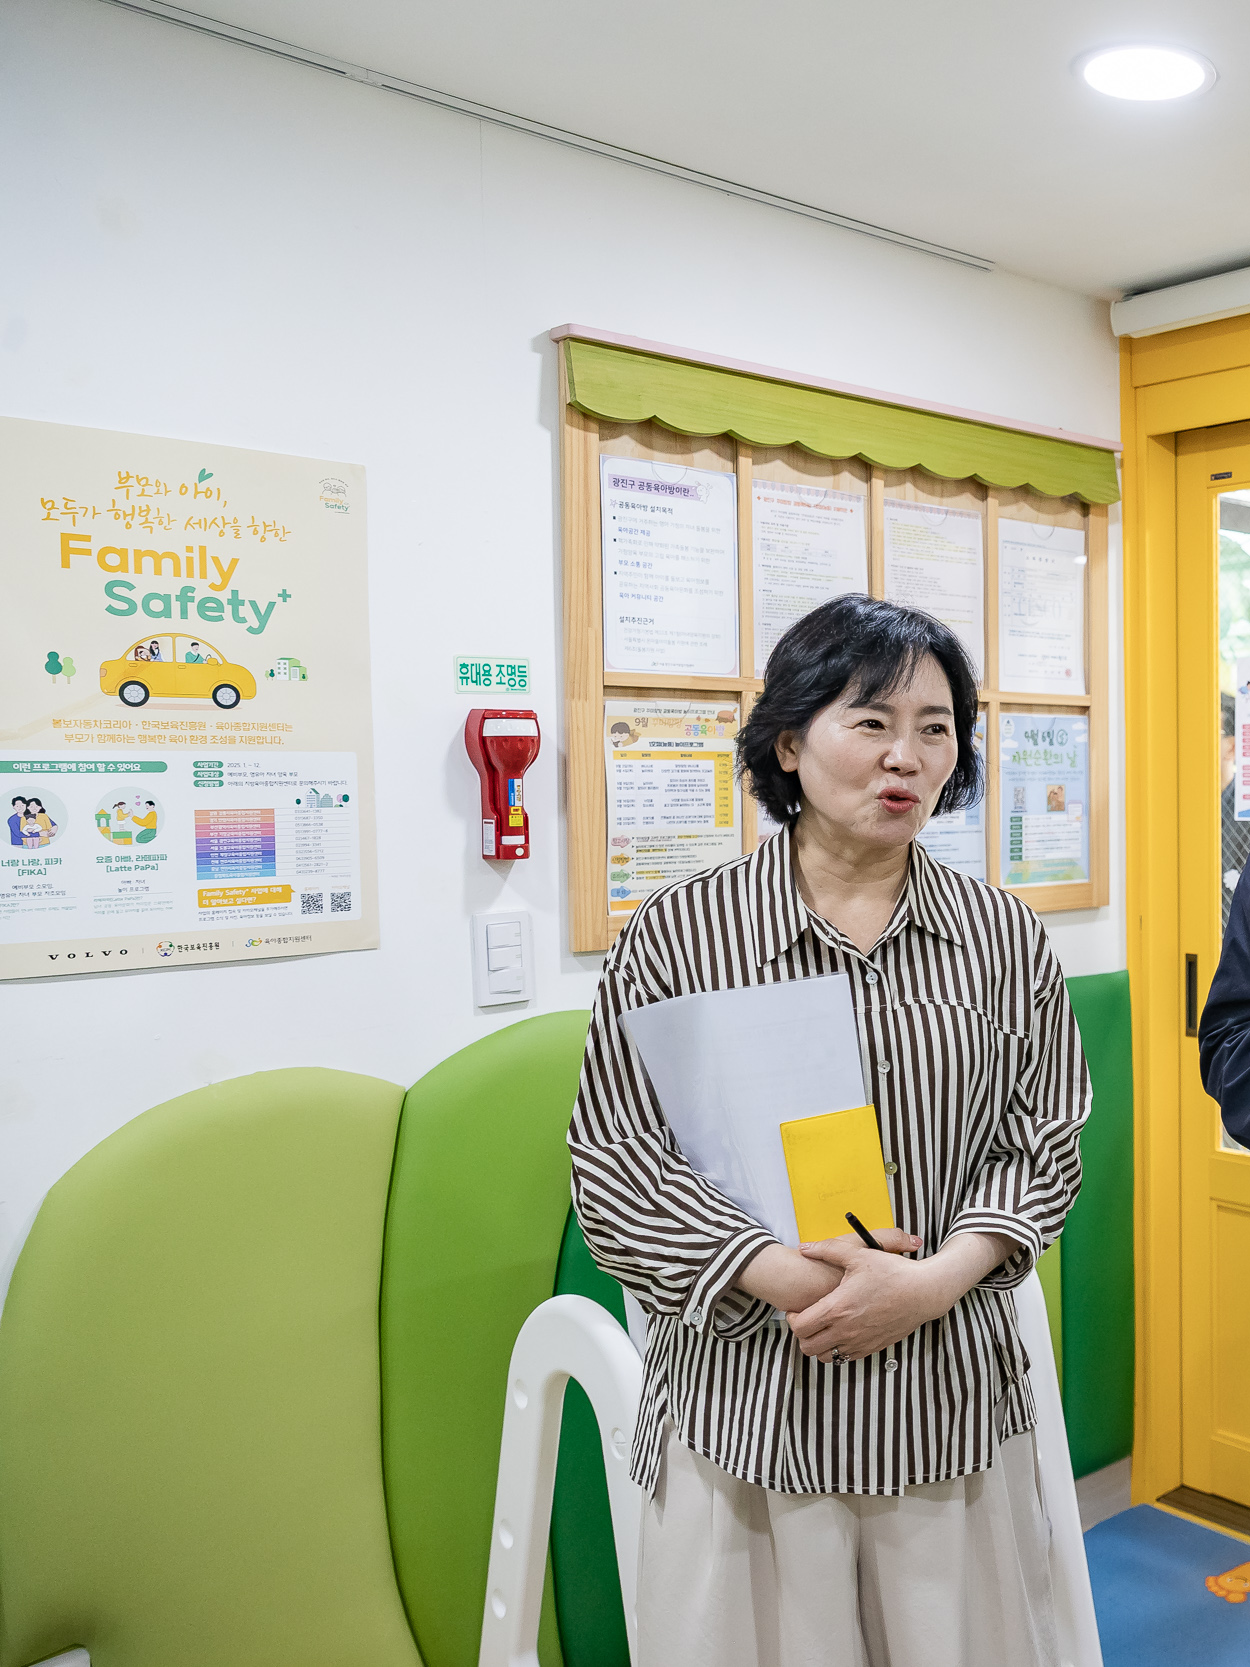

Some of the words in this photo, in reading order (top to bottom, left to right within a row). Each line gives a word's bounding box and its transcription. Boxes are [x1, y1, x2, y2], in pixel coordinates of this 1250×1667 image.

[114, 471, 171, 500] 부모와
[179, 482, 227, 507] 아이,
[613, 478, 636, 489] 광진구
[320, 496, 344, 504] Family
[619, 500, 648, 512] 공동육아방
[650, 506, 673, 514] 설치목적
[40, 497, 101, 526] 모두가
[106, 499, 177, 534] 행복한
[184, 516, 241, 539] 세상을
[247, 516, 291, 542] 향한
[618, 526, 638, 535] 육아공간
[60, 532, 240, 591] Family
[619, 616, 654, 624] 설치추진근거
[459, 663, 492, 686] 휴대용
[496, 664, 527, 688] 조명등
[52, 718, 131, 730] 볼보자동차코리아
[142, 720, 206, 730] 한국보육진흥원
[216, 722, 293, 732] 육아종합지원센터는
[634, 718, 648, 728] 9월
[64, 734, 94, 743] 부모가
[97, 734, 136, 744] 함께하는
[138, 734, 166, 744] 행복한
[169, 734, 187, 744] 육아
[189, 734, 208, 744] 환경
[210, 735, 236, 744] 조성을
[238, 736, 284, 745] 지원합니다.
[1012, 749, 1063, 767] 자원순환의
[12, 762, 31, 772] 이런
[32, 762, 76, 772] 프로그램에
[78, 762, 94, 772] 참여
[96, 762, 106, 772] 할
[107, 763, 116, 772] 수
[117, 763, 142, 772] 있어요
[264, 935, 312, 944] 육아종합지원센터
[177, 942, 220, 952] 한국보육진흥원
[48, 948, 128, 960] VOLVO
